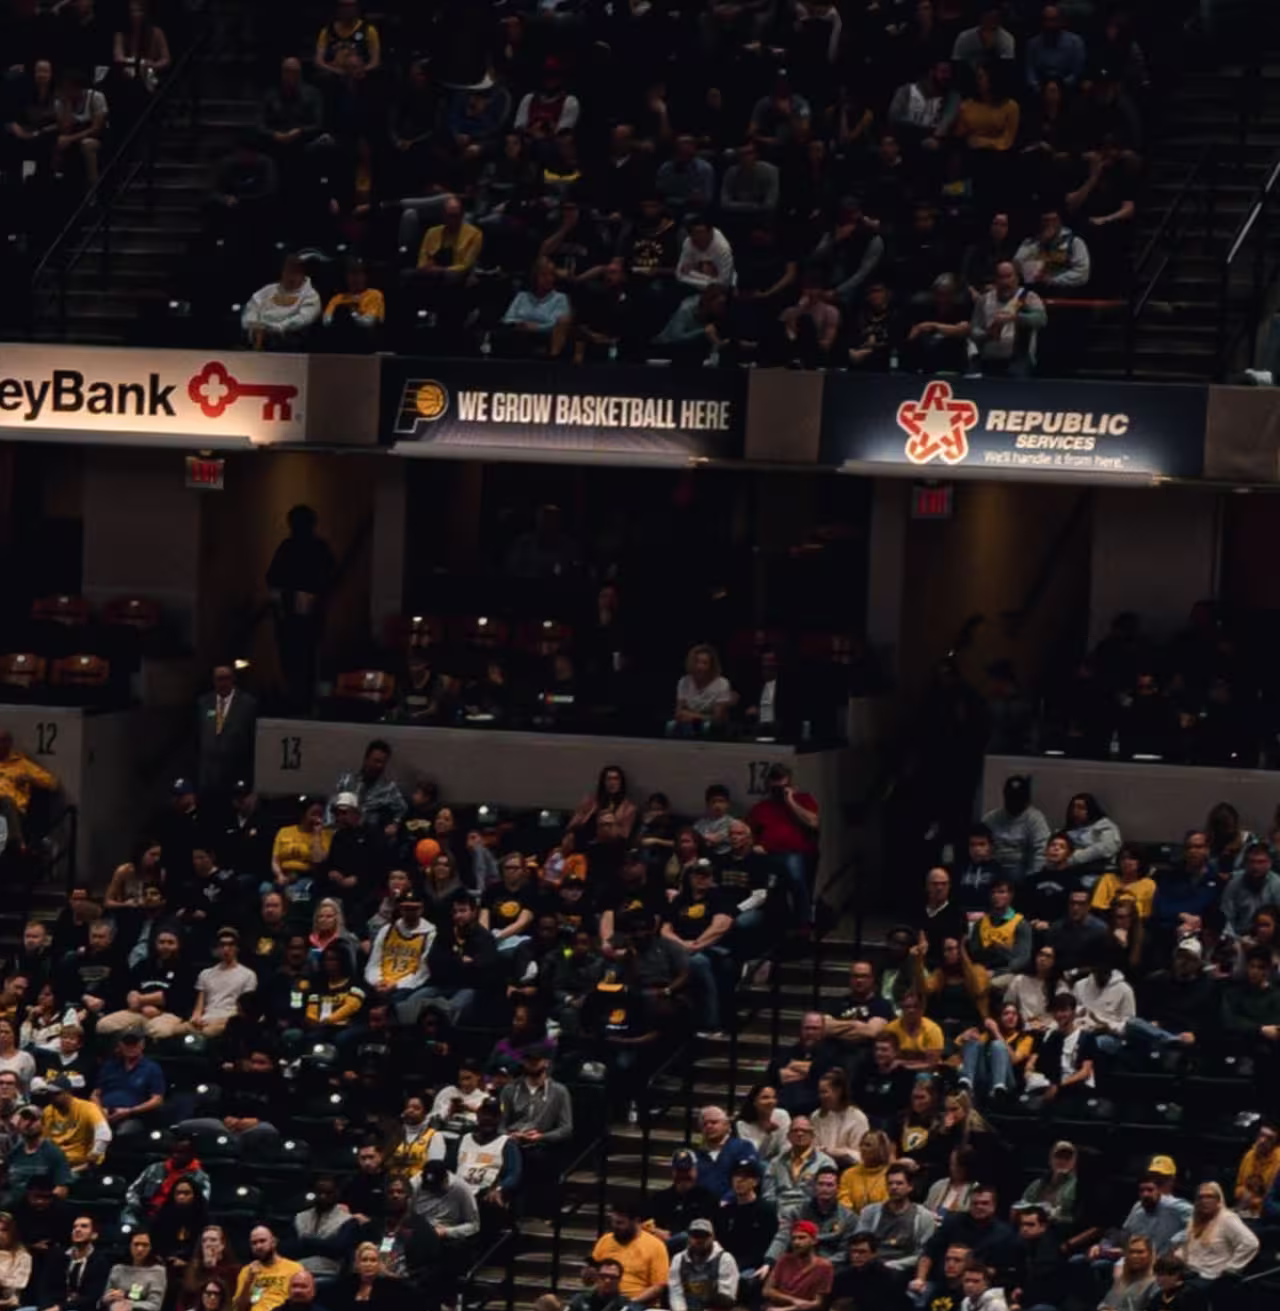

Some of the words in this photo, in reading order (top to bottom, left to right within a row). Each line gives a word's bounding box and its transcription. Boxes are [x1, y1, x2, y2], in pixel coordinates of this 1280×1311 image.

[457, 391, 488, 421] WE
[492, 392, 551, 424] GROW
[556, 395, 676, 428] BASKETBALL
[680, 400, 730, 430] HERE
[986, 410, 1129, 436] REPUBLIC
[1015, 434, 1096, 451] SERVICES
[36, 722, 57, 755] 12
[280, 737, 302, 770] 13
